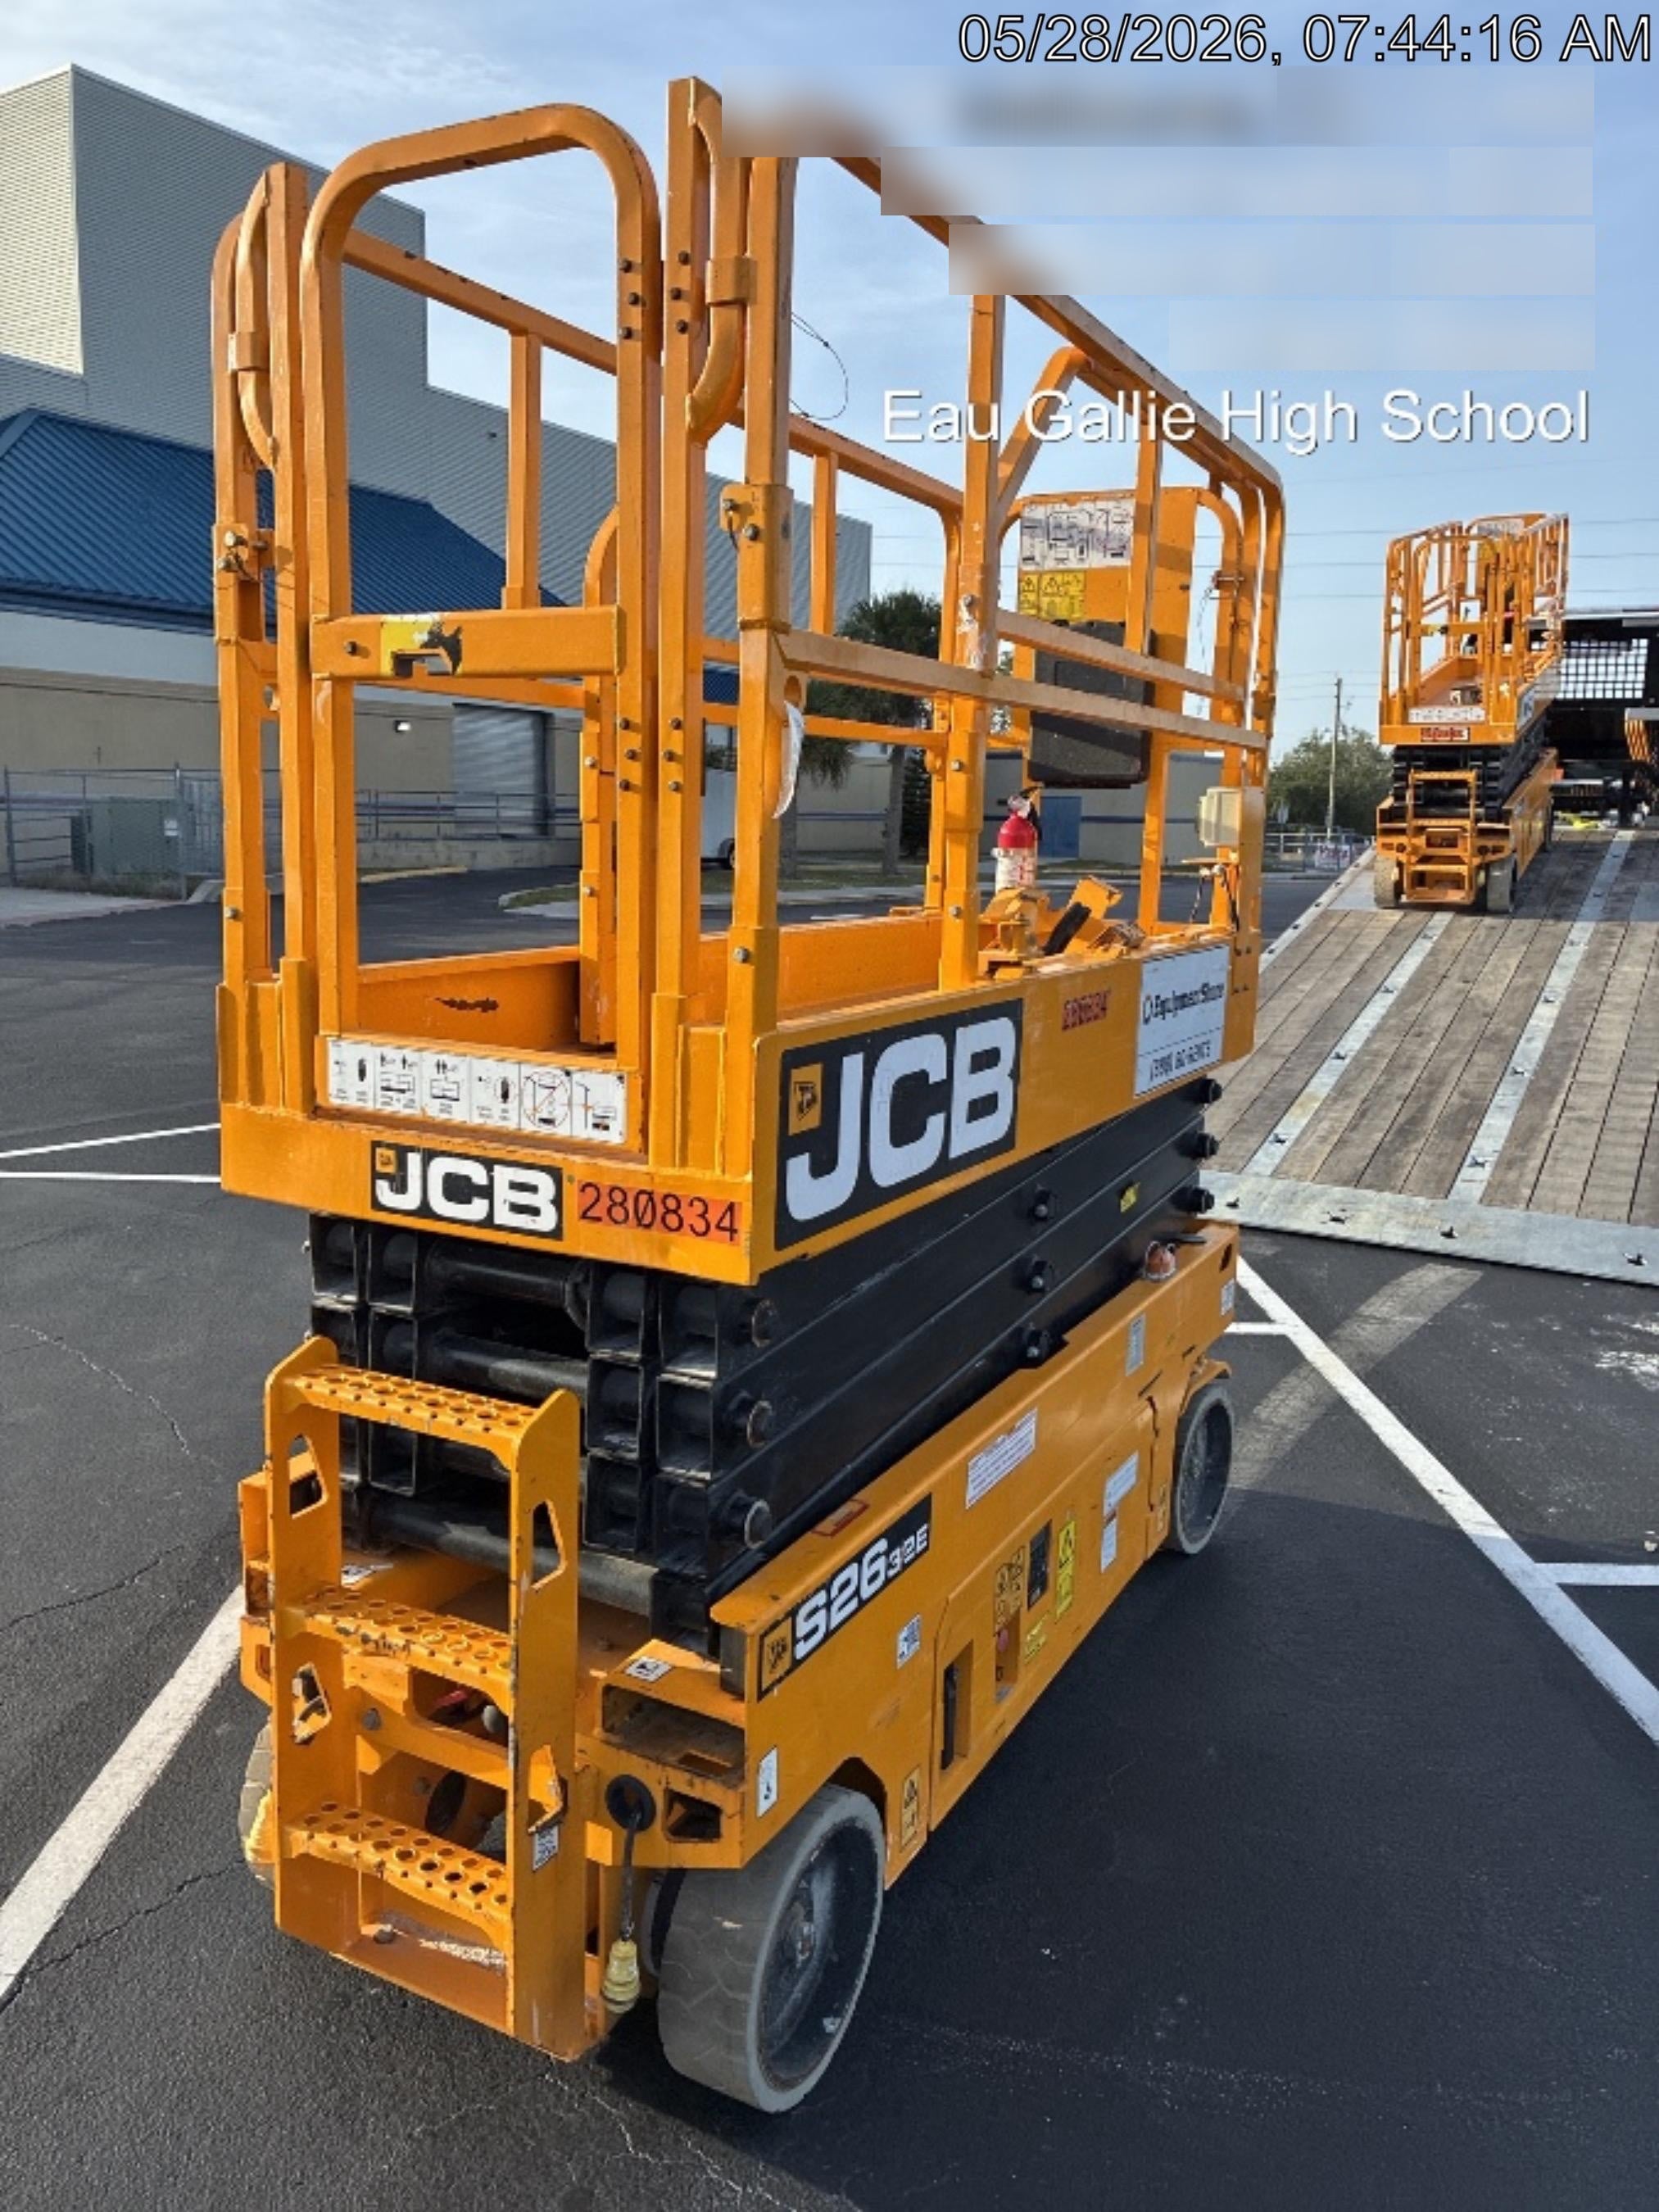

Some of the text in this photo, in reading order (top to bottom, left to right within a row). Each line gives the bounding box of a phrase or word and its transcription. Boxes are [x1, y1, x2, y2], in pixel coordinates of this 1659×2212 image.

[786, 1017, 1016, 1223] JCB
[375, 1152, 559, 1233] JCB
[579, 1182, 739, 1242] 280834
